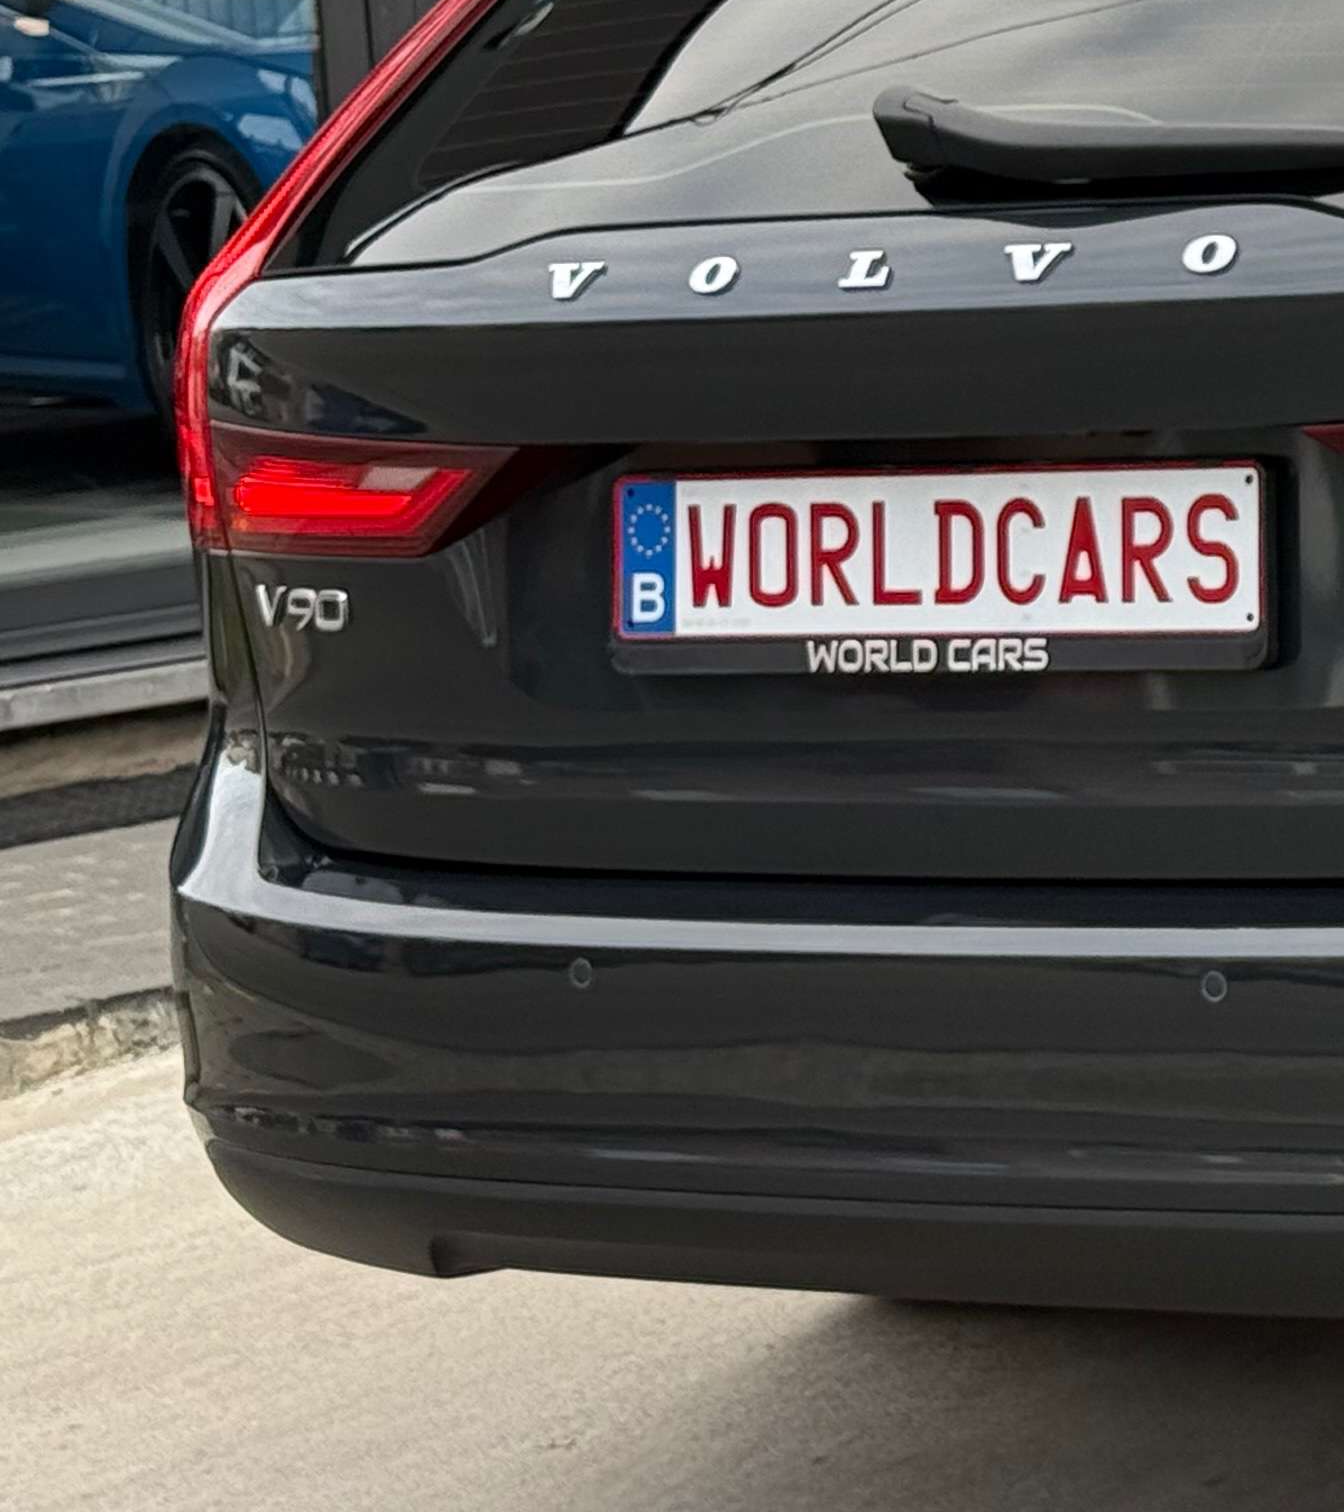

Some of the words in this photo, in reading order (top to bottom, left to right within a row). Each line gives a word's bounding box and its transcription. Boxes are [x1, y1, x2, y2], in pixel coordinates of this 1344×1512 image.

[547, 232, 1240, 301] VOLVO
[632, 573, 665, 623] B
[686, 492, 1241, 608] WORLDCARS
[255, 583, 350, 632] V90
[806, 639, 937, 673] WORLD
[947, 637, 1050, 672] CARS
